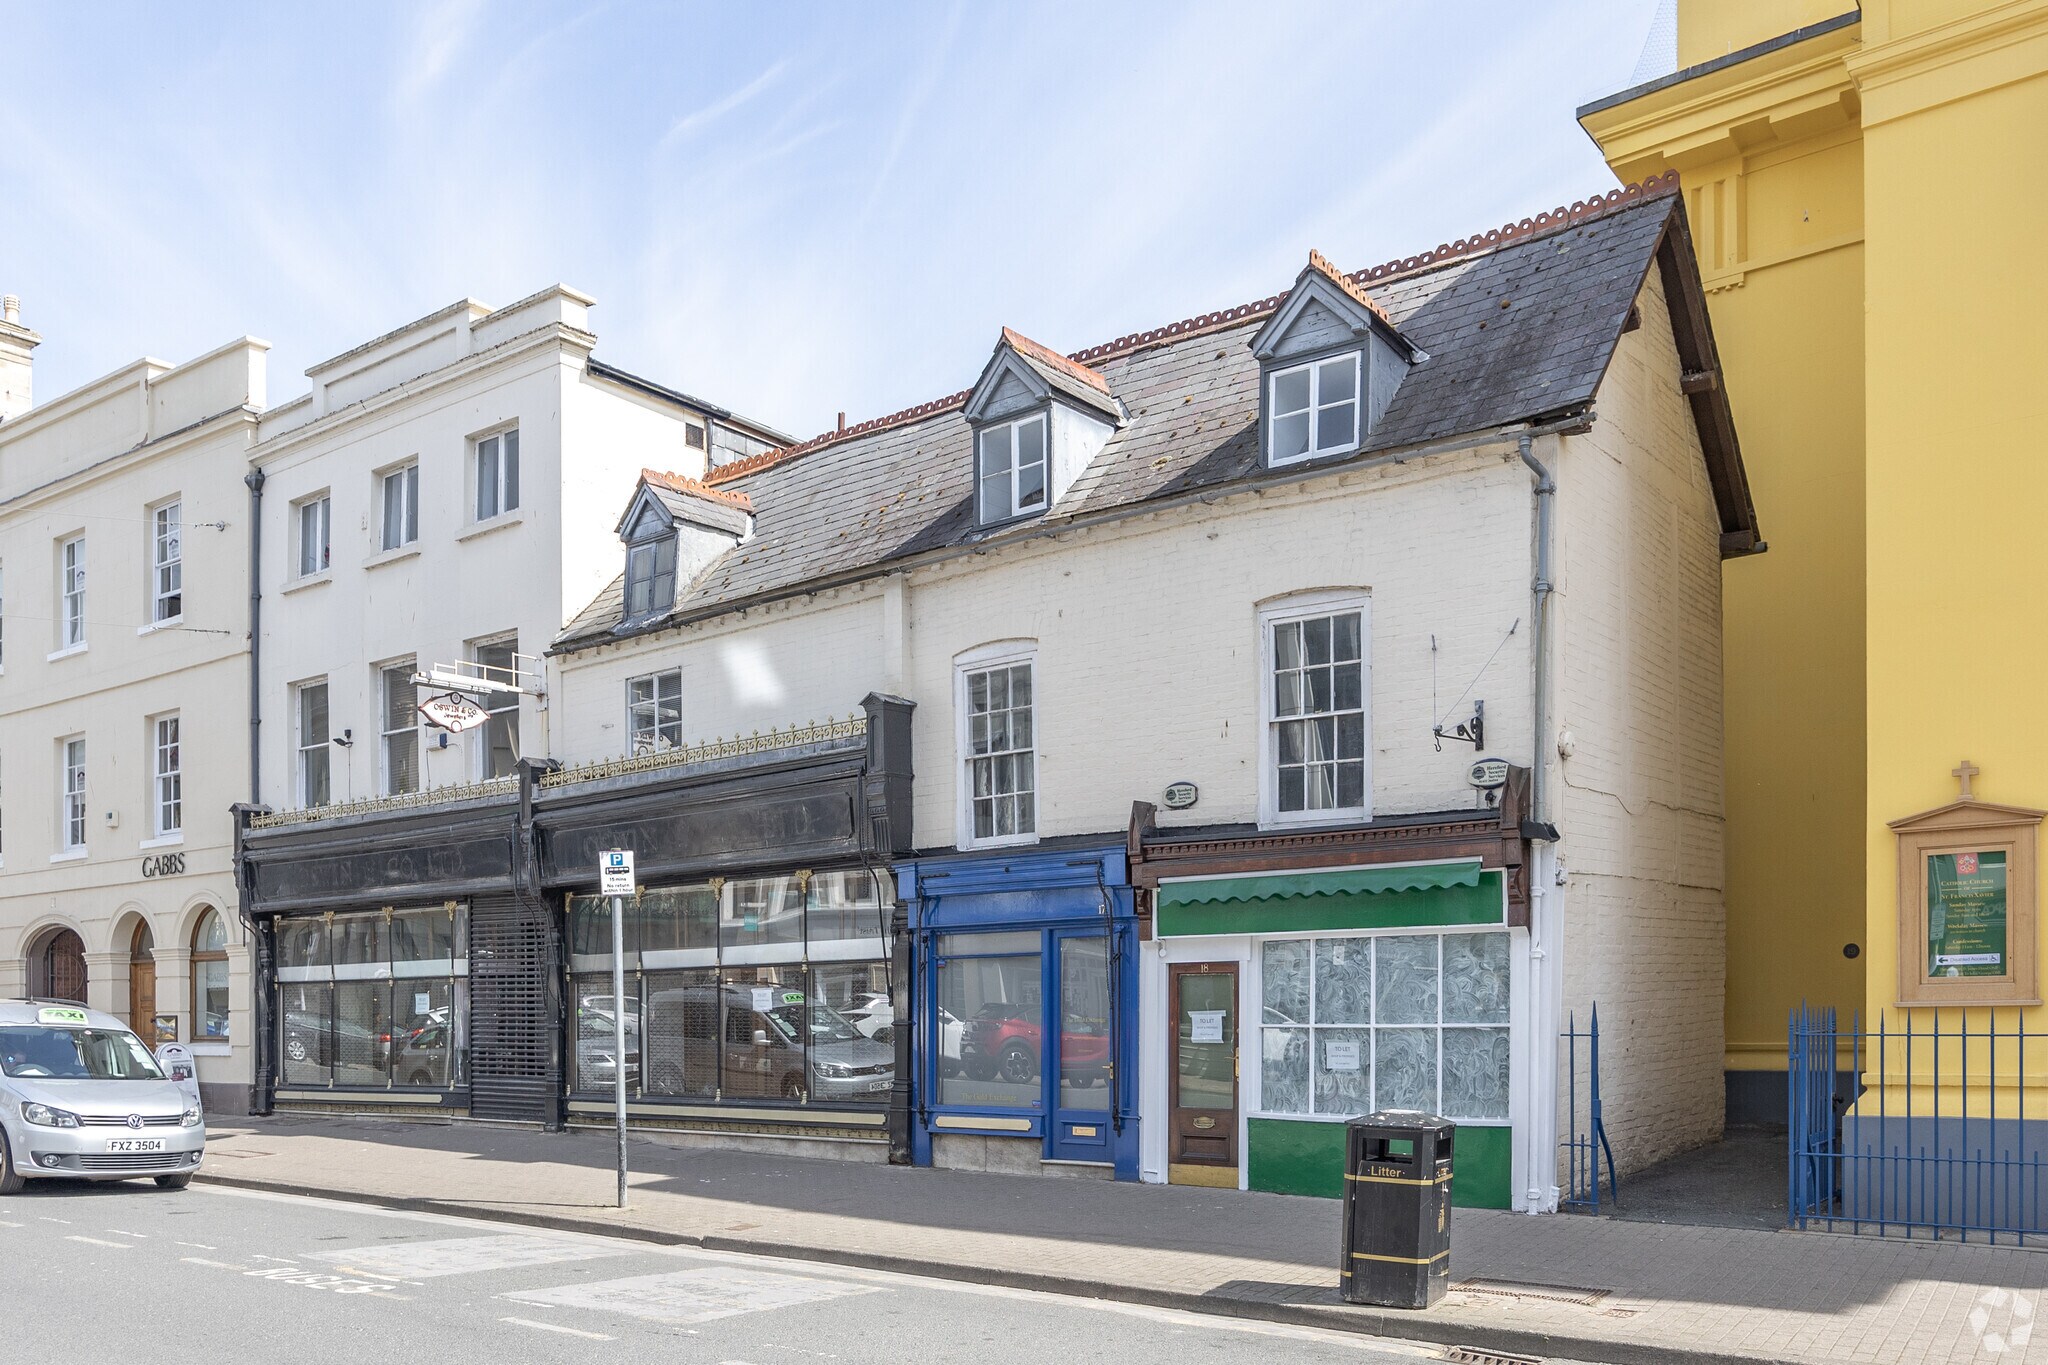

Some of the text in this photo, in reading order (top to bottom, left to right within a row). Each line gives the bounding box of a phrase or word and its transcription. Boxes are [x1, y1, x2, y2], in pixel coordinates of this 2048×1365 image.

[434, 703, 459, 713] OSWIN
[142, 852, 185, 878] GABBS
[1200, 963, 1209, 973] 18
[44, 1011, 84, 1019] TAXI
[111, 1140, 161, 1151] FXZ 3504
[1371, 1165, 1402, 1178] Litter
[242, 1267, 397, 1294] BUSES
